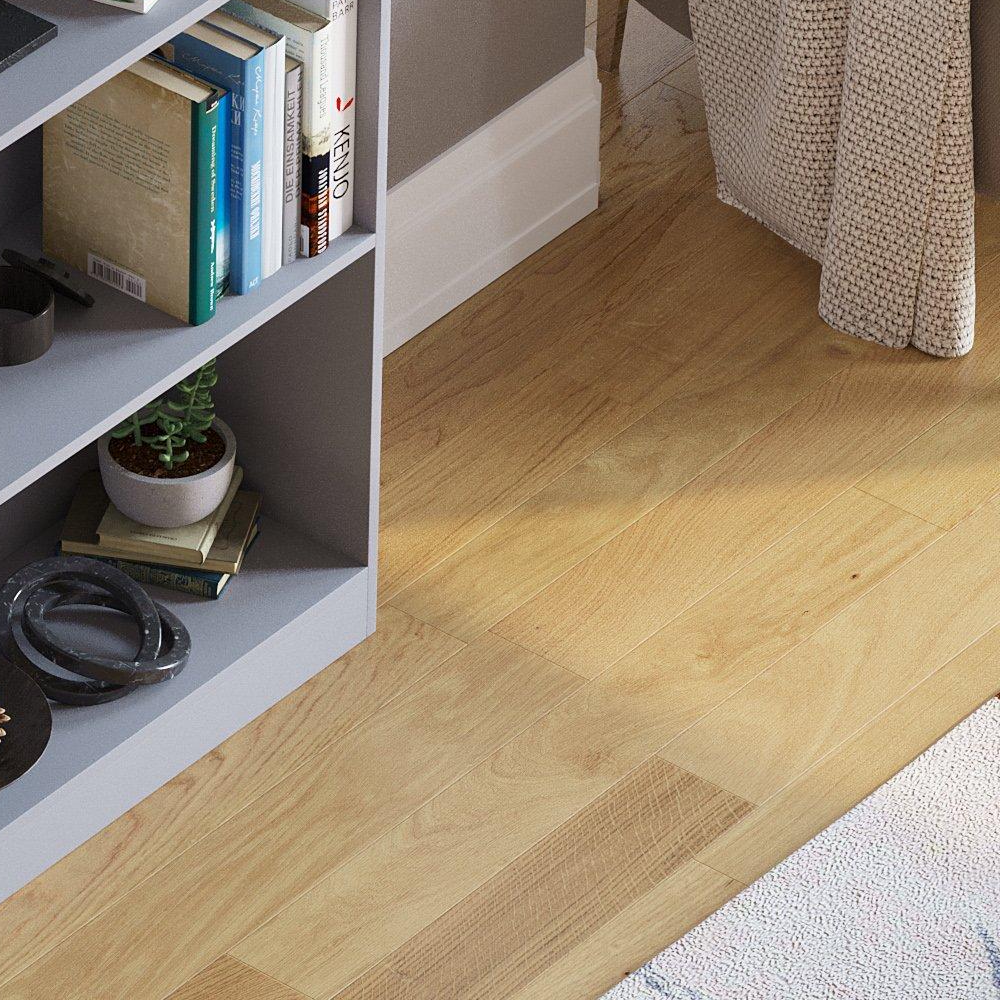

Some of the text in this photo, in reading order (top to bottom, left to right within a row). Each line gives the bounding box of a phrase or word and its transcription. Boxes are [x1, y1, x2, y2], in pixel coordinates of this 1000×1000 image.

[332, 1, 354, 21] BARR
[285, 90, 296, 204] DIE EINSAMKEIT
[333, 124, 350, 199] KENJO
